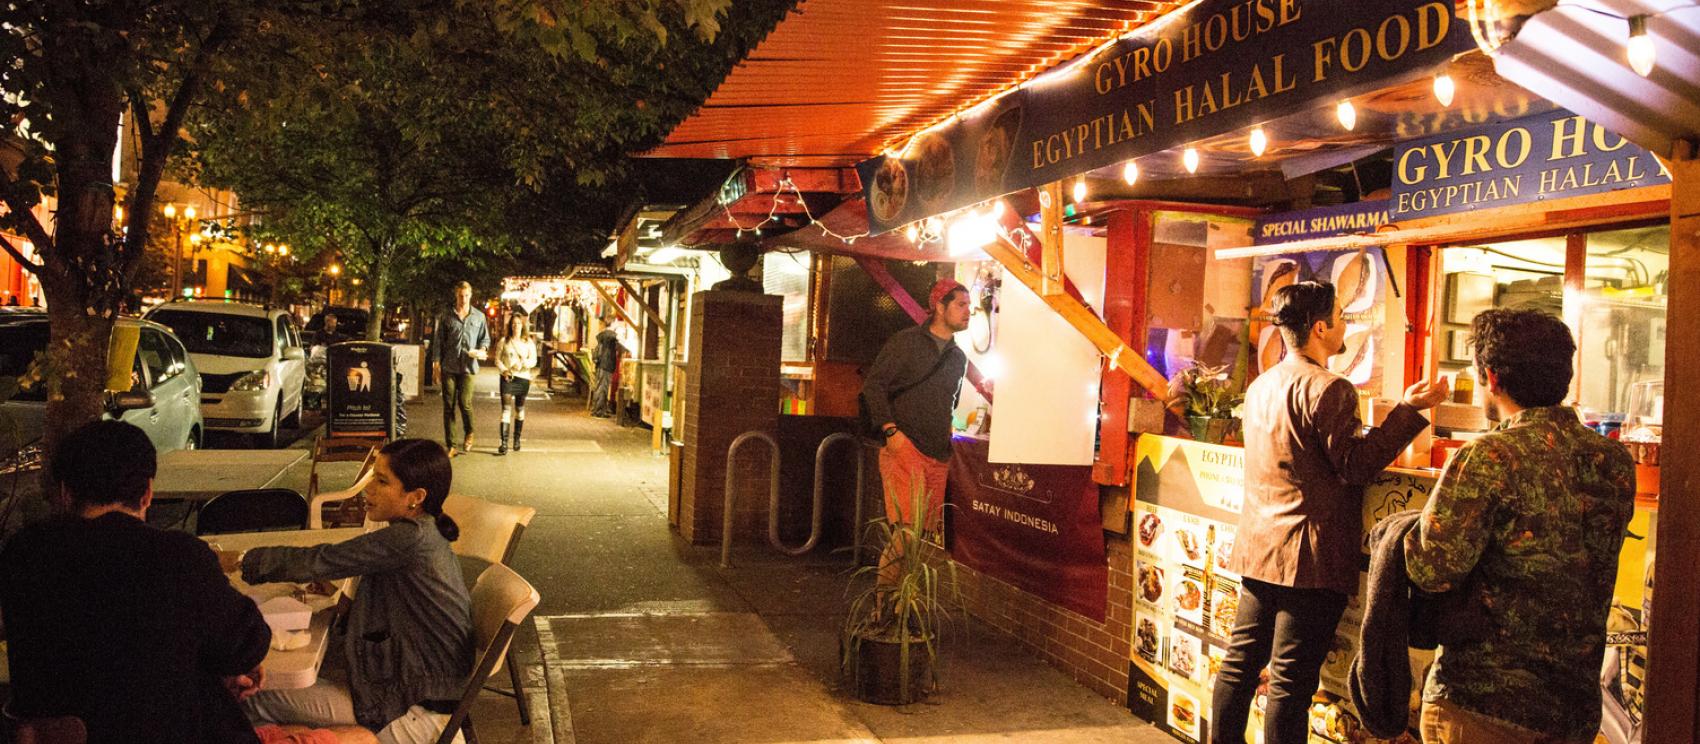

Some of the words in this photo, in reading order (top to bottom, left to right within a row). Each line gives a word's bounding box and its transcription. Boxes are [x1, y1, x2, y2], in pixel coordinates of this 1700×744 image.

[1095, 39, 1172, 95] GYRO
[1181, 0, 1301, 63] HOUSE
[1032, 99, 1155, 169] EGYPTIAN
[1174, 54, 1296, 124] HALAL
[1312, 2, 1449, 83] FOOD
[1397, 175, 1521, 214] EGYPTIAN
[1537, 156, 1645, 194] HALAL
[1398, 127, 1532, 185] GYRO
[1262, 219, 1307, 238] SPECIAL
[1310, 210, 1389, 233] SHAWARMA
[972, 499, 1001, 517] SATAY
[1004, 508, 1058, 535] INDONESIA
